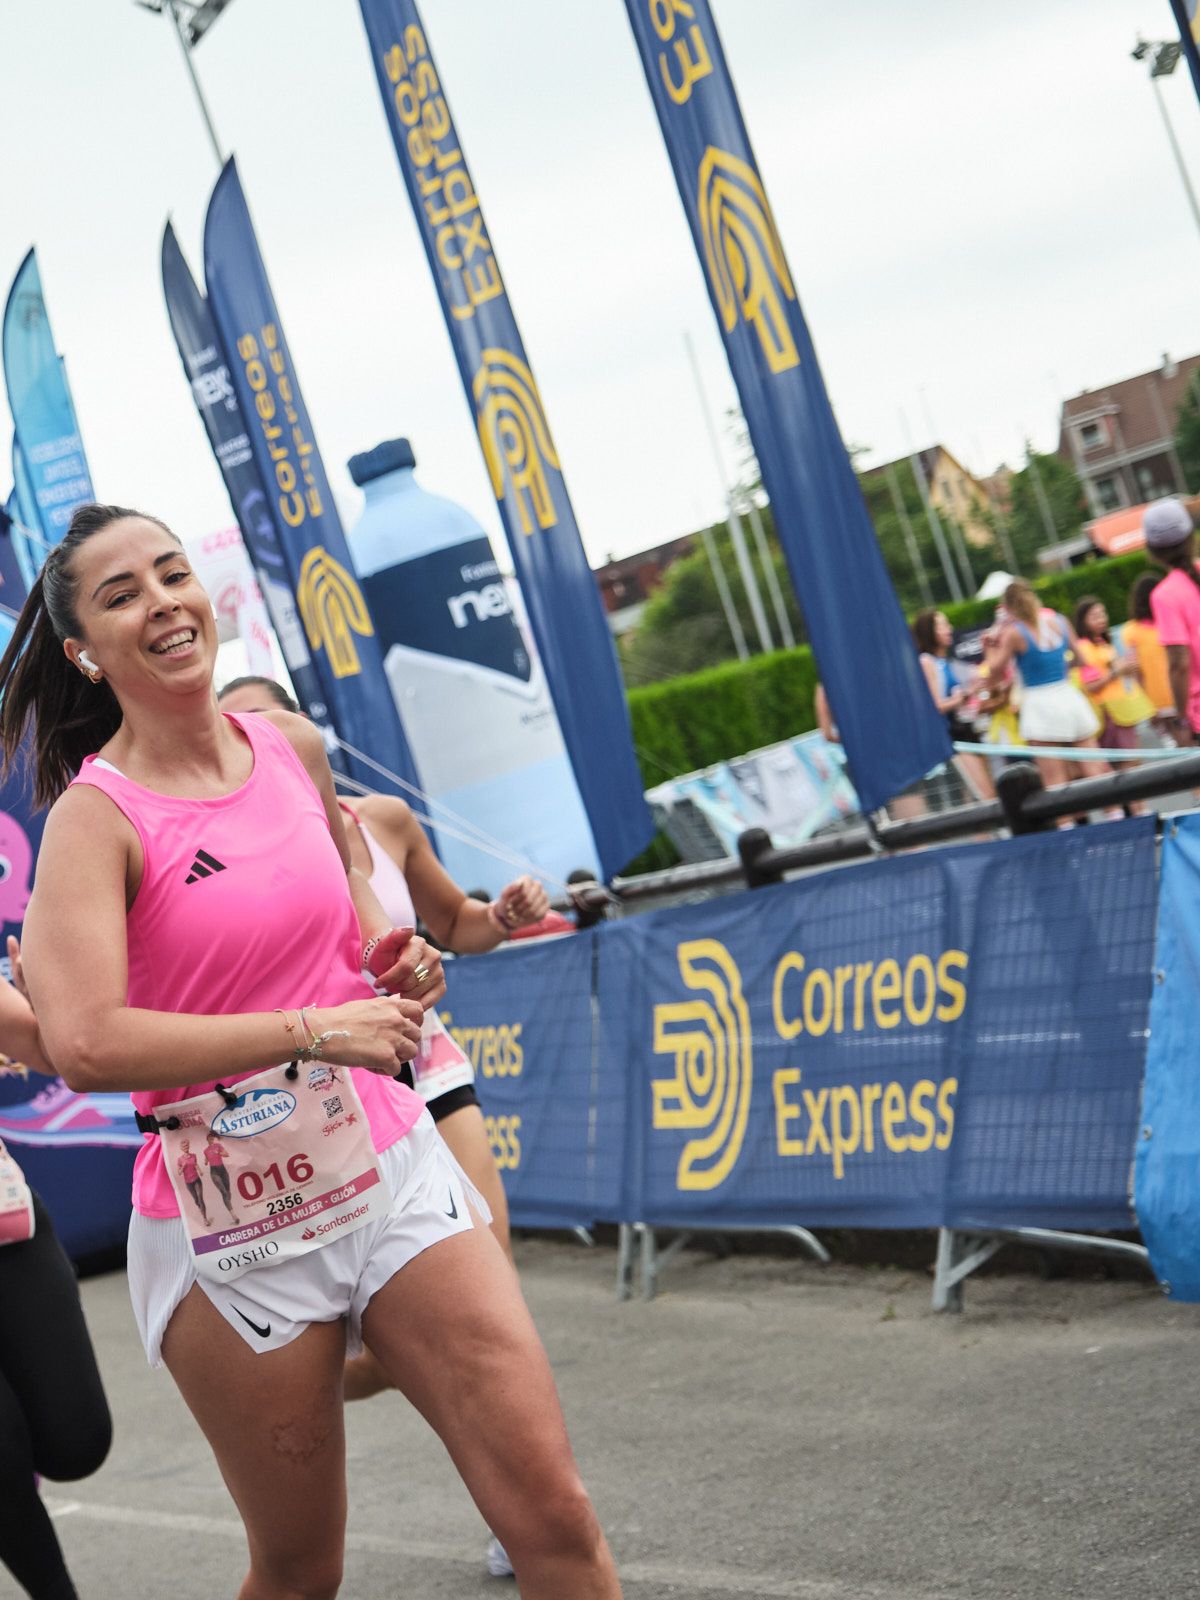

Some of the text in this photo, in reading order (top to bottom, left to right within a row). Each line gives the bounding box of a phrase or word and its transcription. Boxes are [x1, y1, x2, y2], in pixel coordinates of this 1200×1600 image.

[404, 23, 504, 306] Express
[237, 332, 306, 528] Correos
[446, 581, 517, 629] ne
[773, 949, 968, 1040] Correos
[220, 1099, 291, 1134] ASTURIANA
[773, 1068, 958, 1180] Express
[237, 1153, 314, 1201] 016
[219, 1184, 357, 1246] CARRERA DE LA MUJER GIJÓN
[267, 1192, 303, 1216] 2356
[316, 1203, 370, 1236] Santander
[218, 1240, 279, 1272] OYSHO
